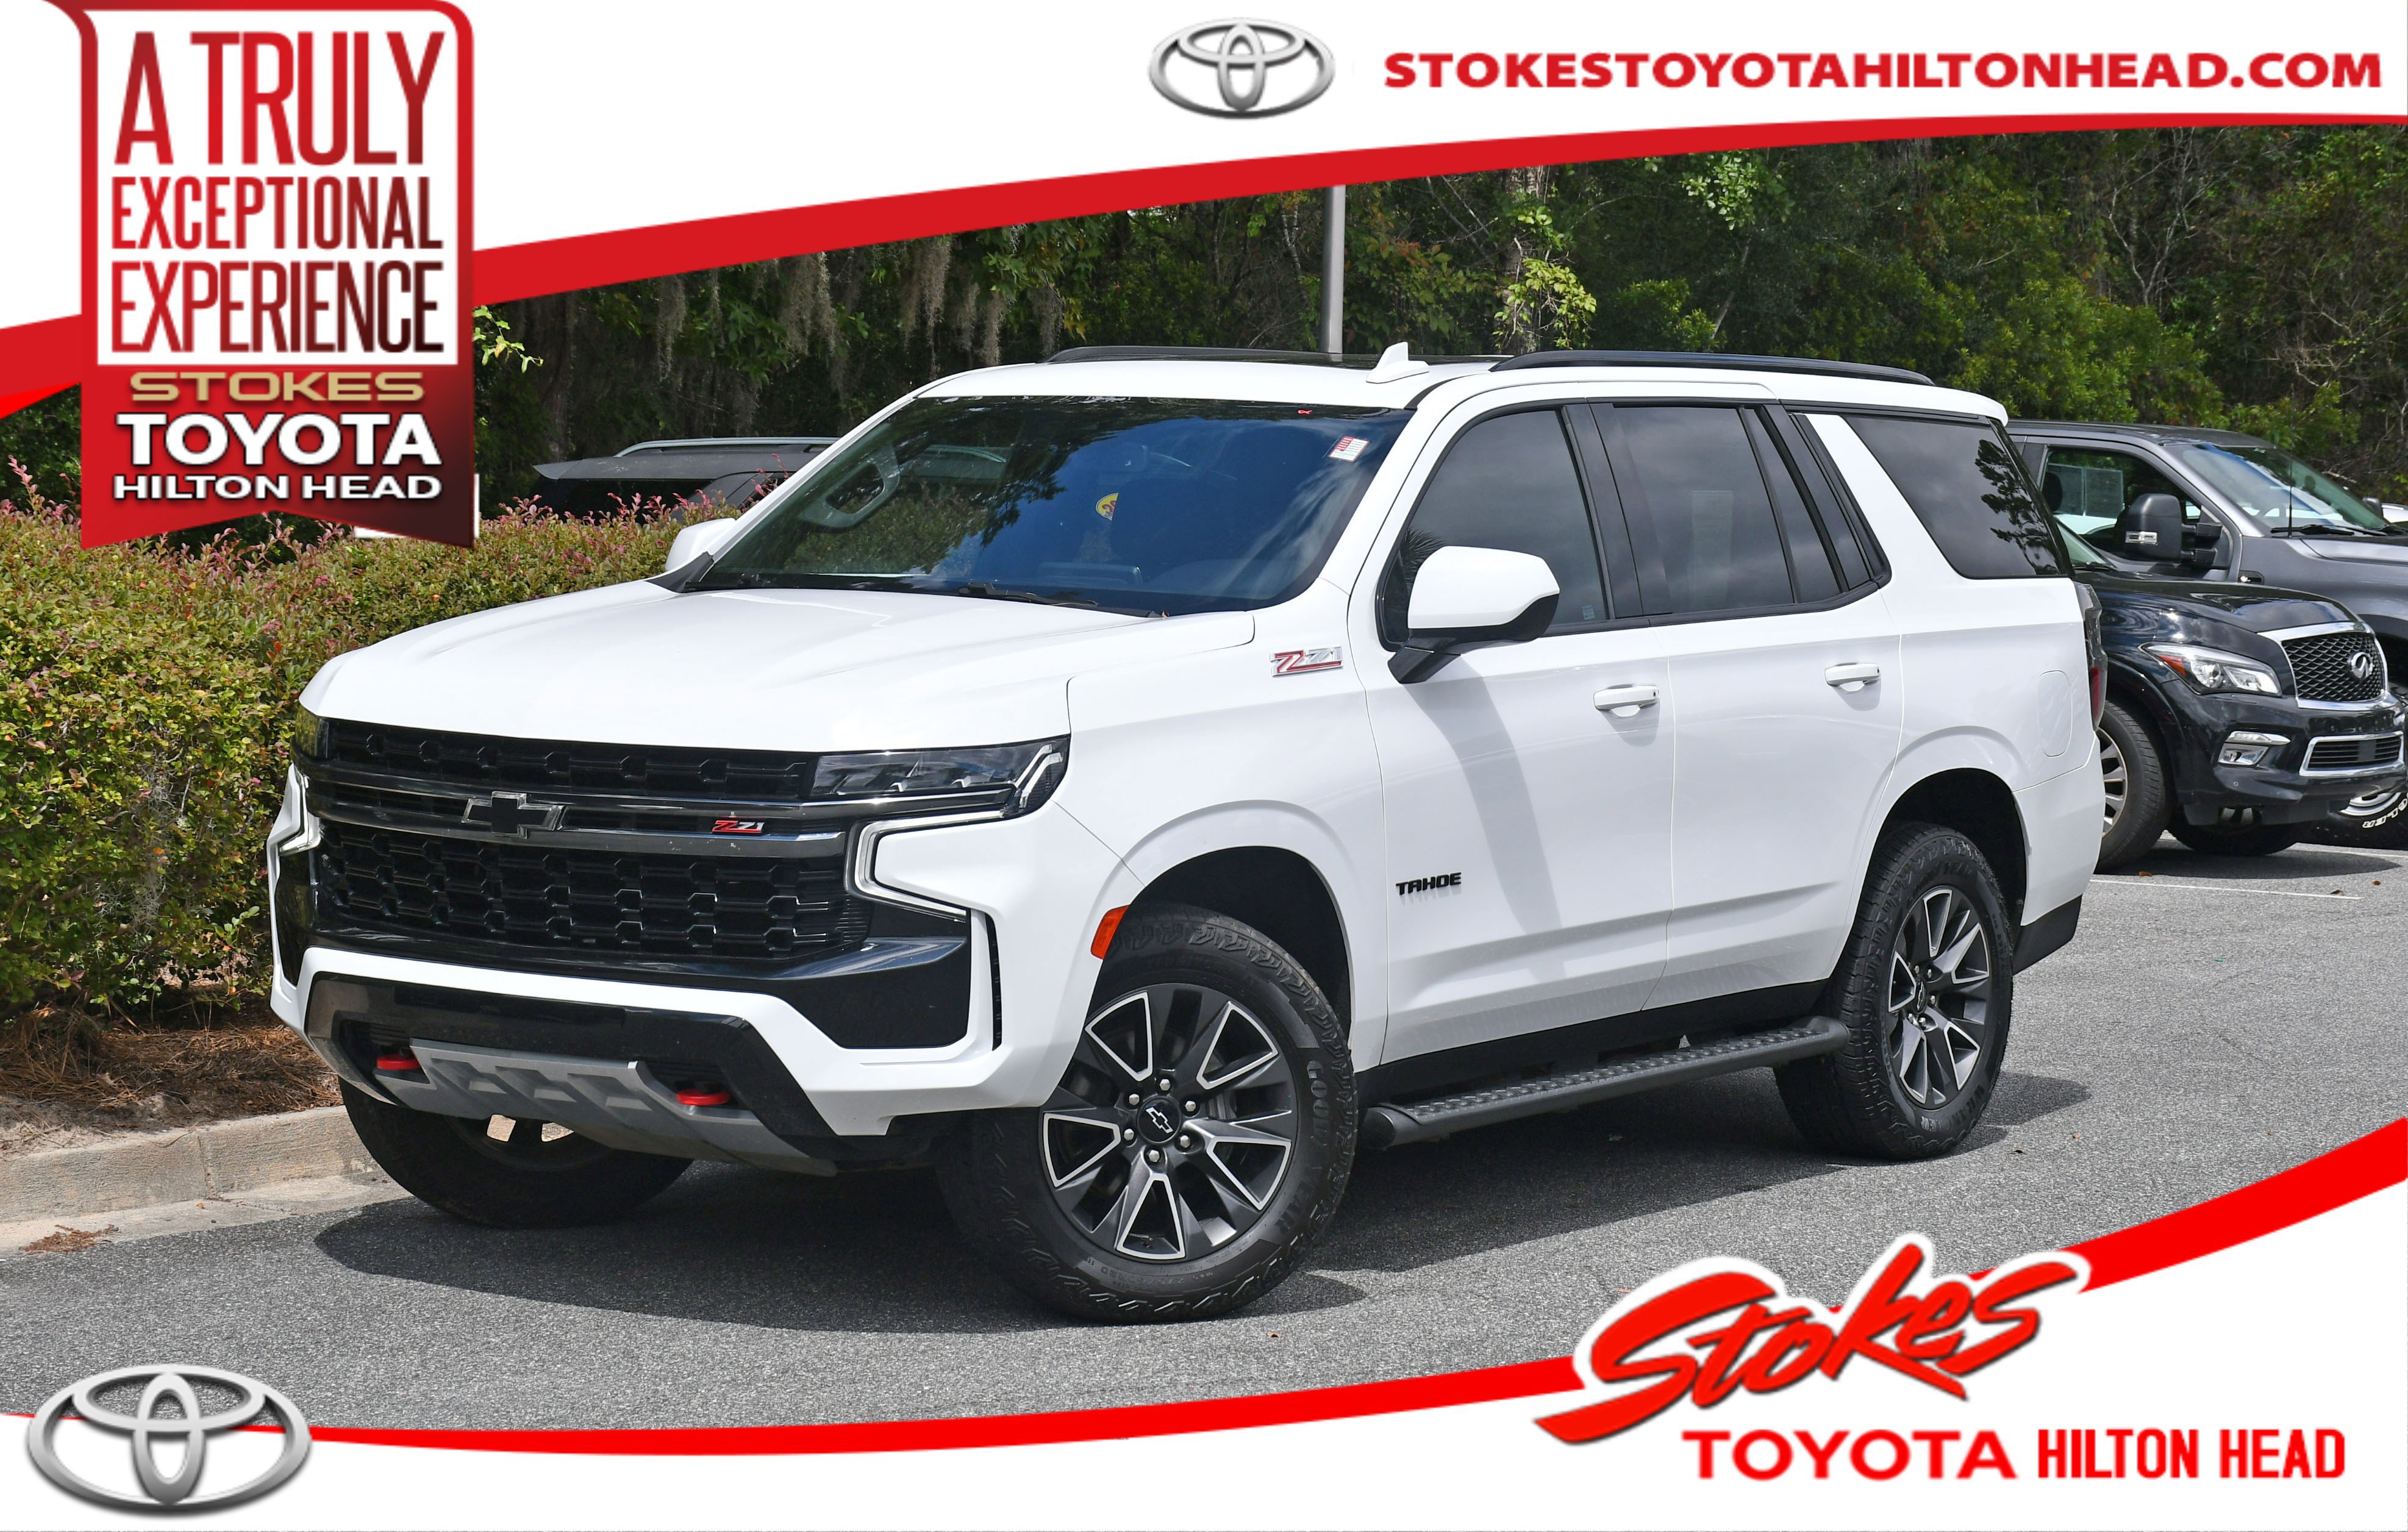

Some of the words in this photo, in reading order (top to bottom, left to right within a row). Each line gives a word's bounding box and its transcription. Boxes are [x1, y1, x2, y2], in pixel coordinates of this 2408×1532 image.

[1269, 646, 1344, 677] Z71
[712, 820, 765, 833] Z71
[1396, 872, 1462, 896] TAHOE
